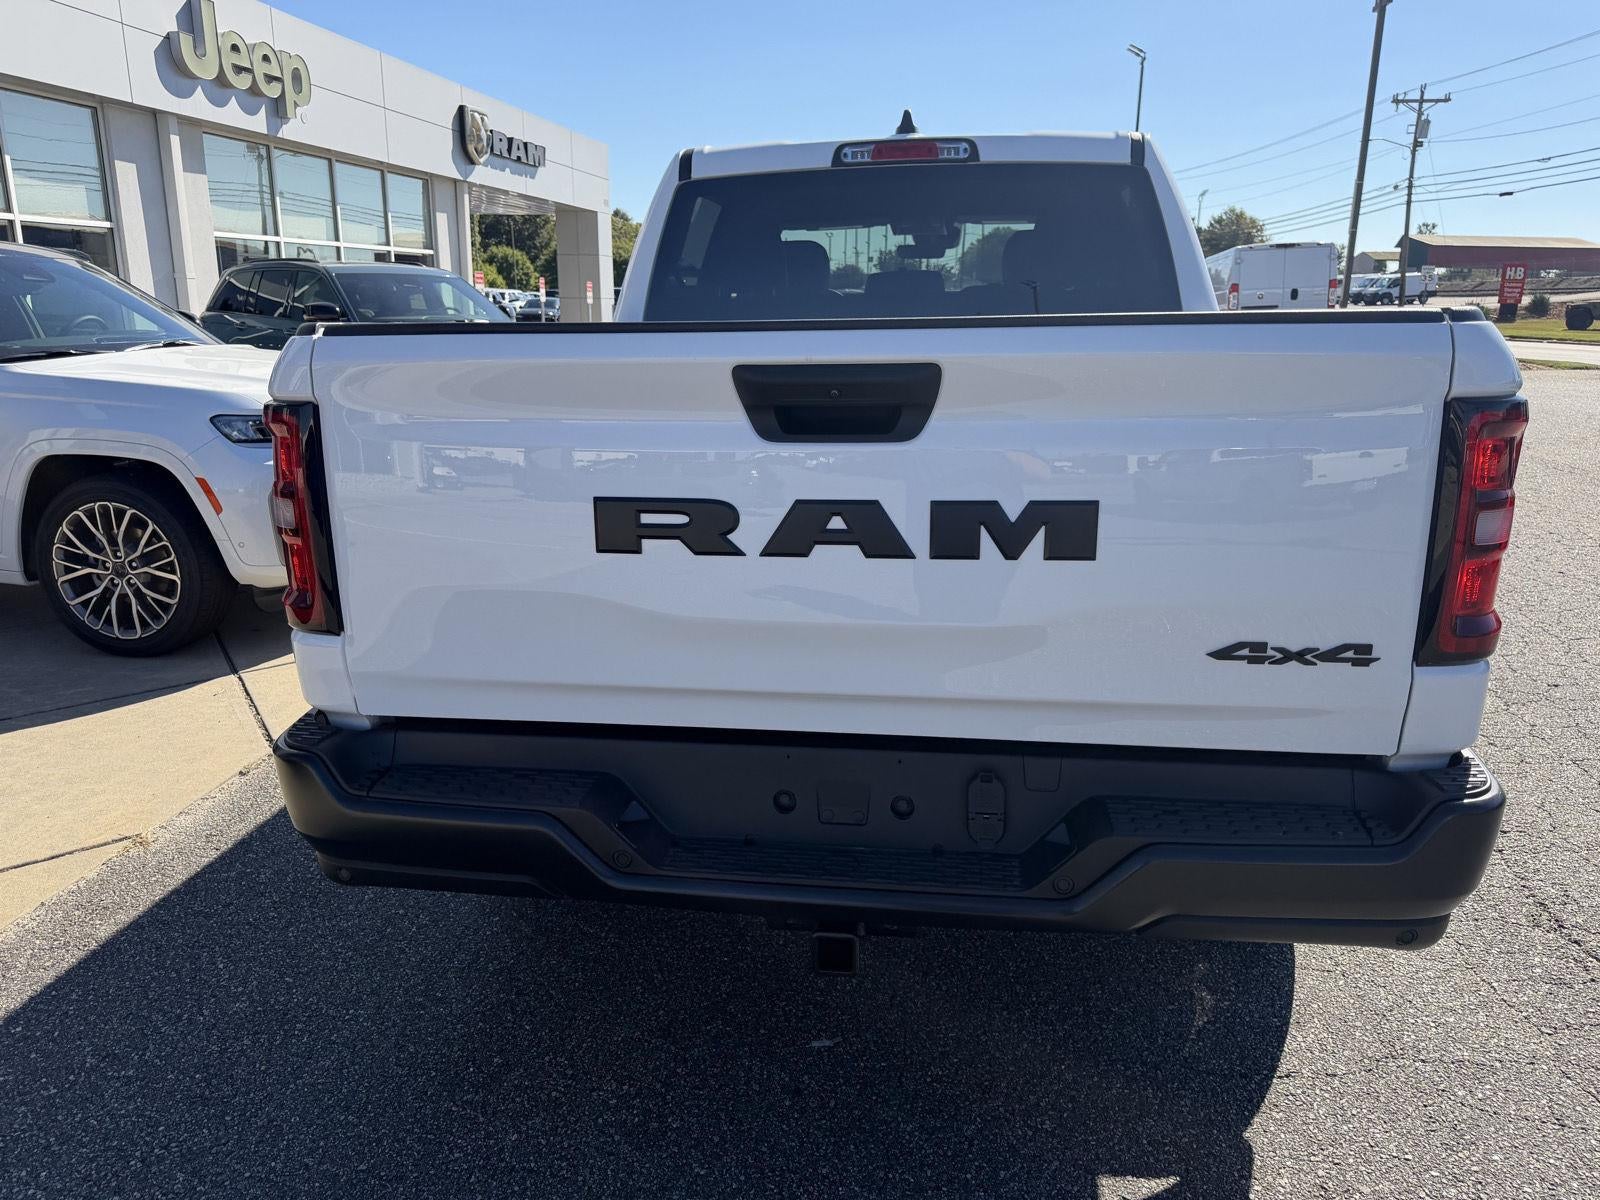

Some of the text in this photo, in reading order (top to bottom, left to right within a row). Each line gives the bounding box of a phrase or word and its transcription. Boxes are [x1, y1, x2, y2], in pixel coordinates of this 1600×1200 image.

[169, 0, 311, 118] Jeep
[490, 130, 546, 168] RAM
[593, 496, 1099, 561] RAM
[1205, 641, 1381, 667] 4x4
